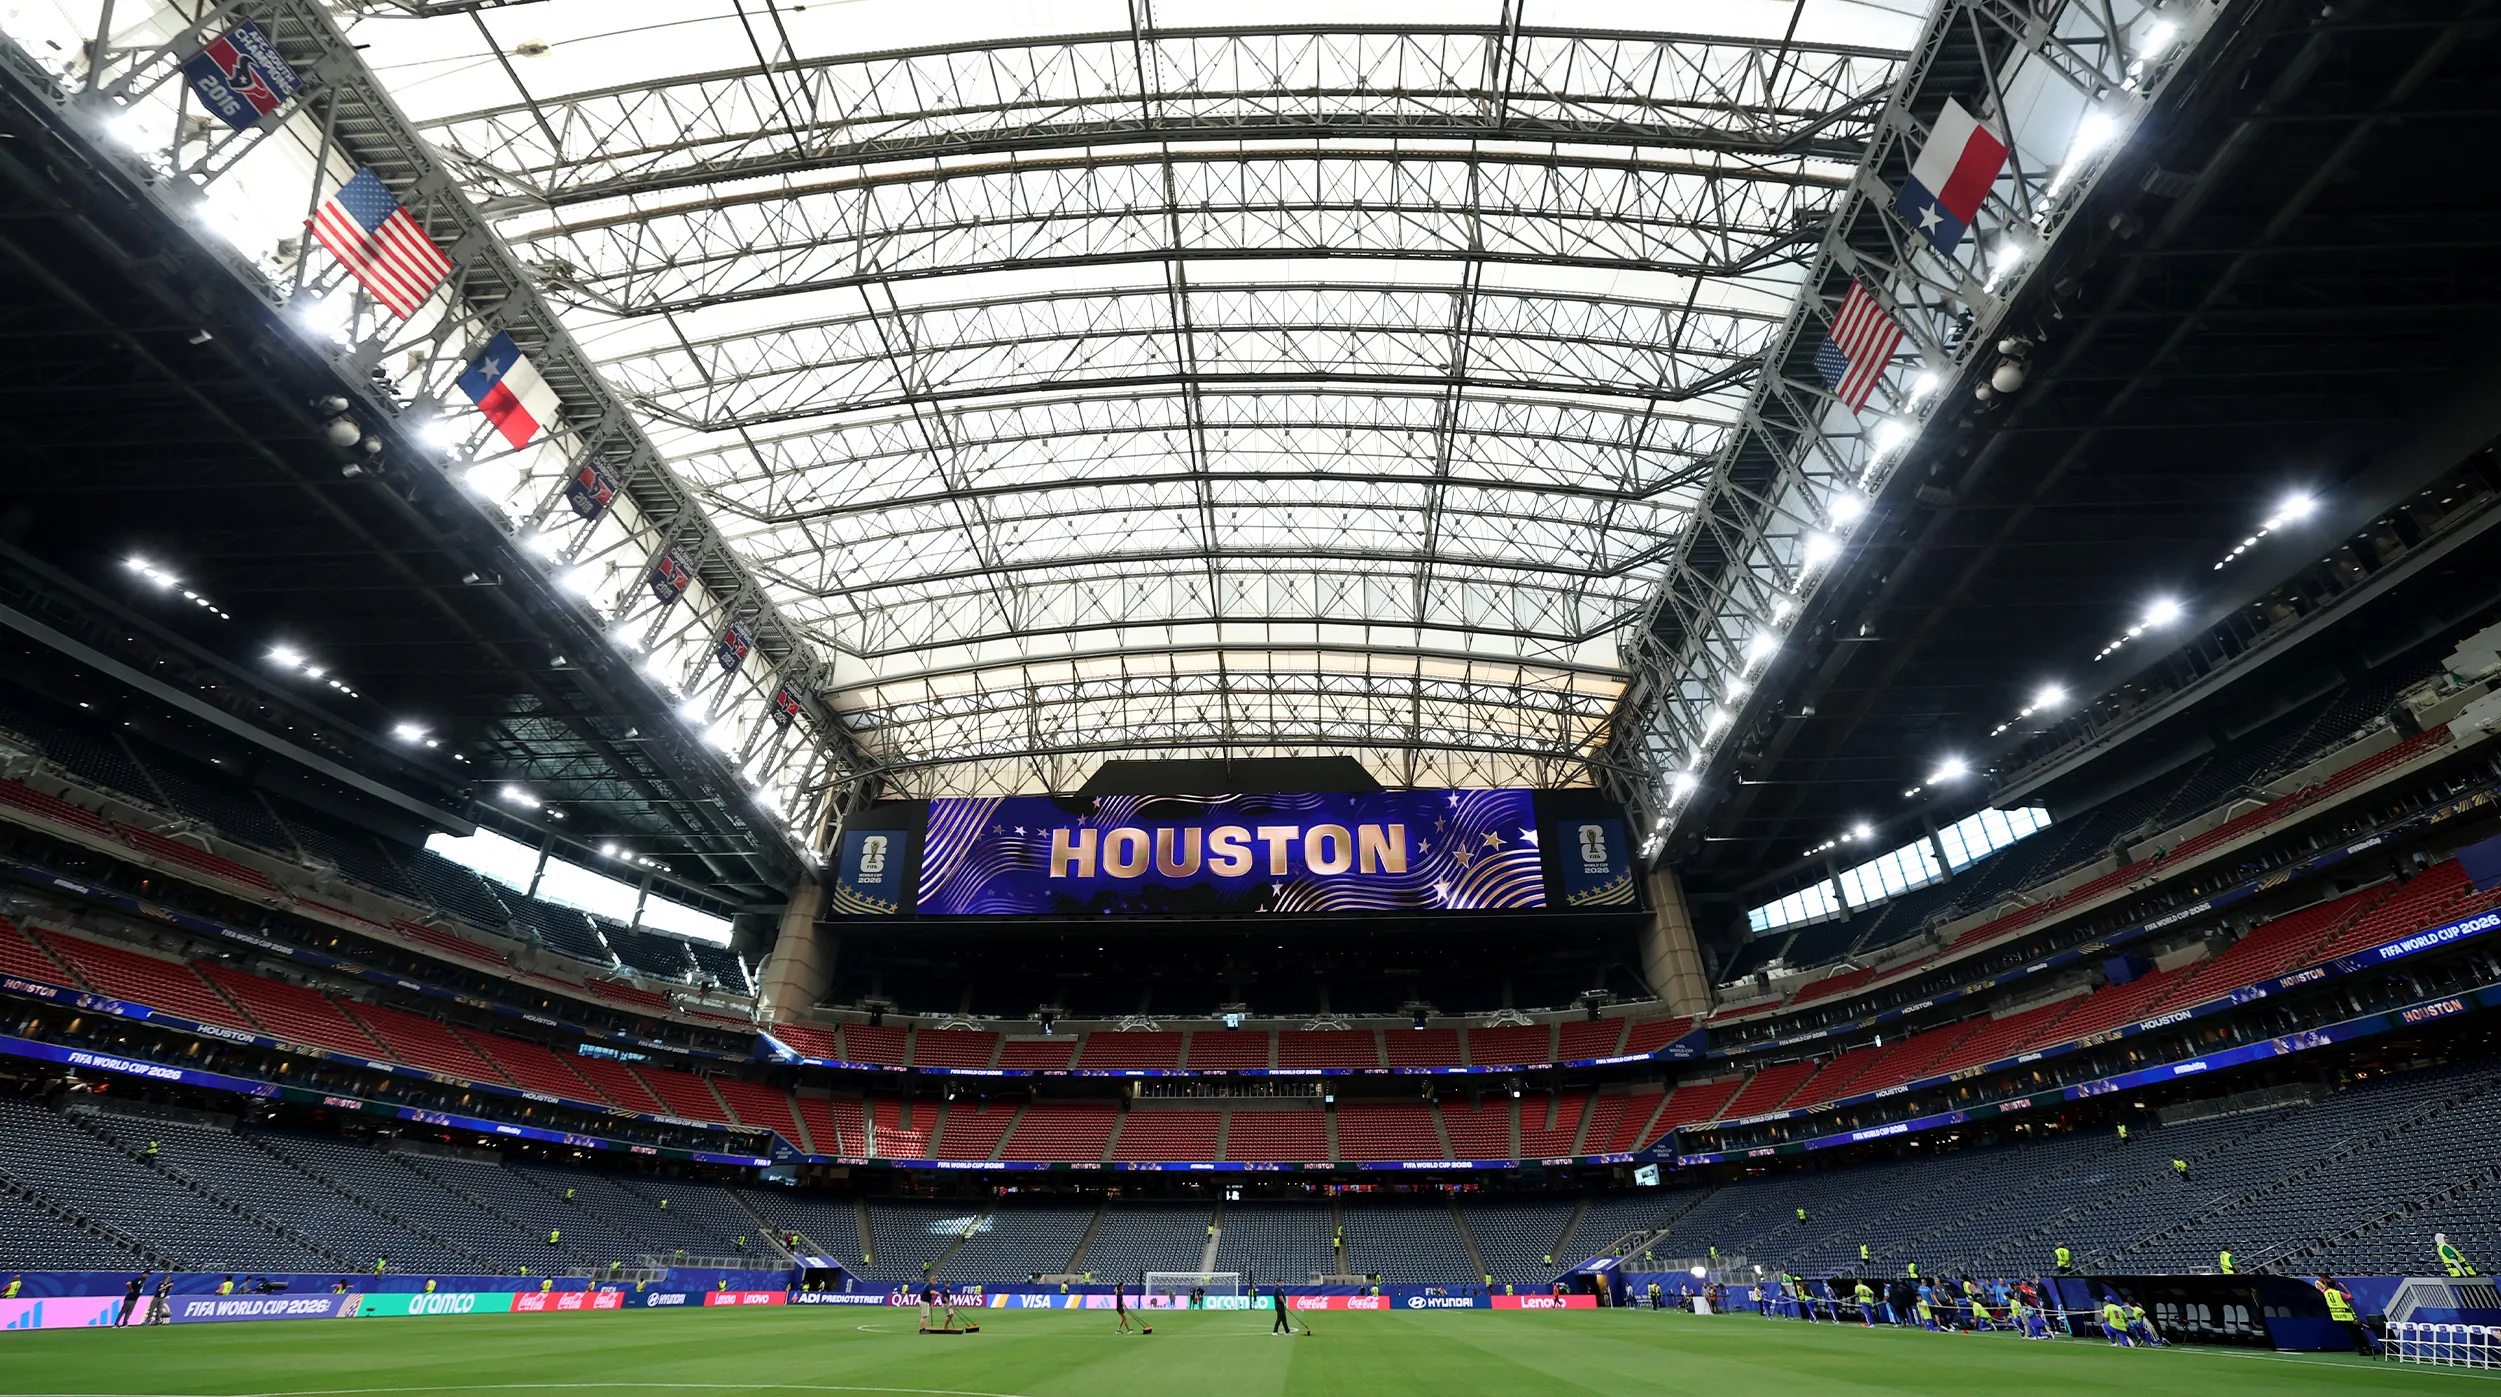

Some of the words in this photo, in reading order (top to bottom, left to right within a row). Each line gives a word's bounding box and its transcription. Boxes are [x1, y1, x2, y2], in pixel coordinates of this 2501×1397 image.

[234, 28, 295, 95] CHAMPIONS
[249, 30, 269, 51] AFC
[266, 49, 296, 82] SOUTH
[198, 74, 241, 117] 2016
[655, 580, 673, 599] 2019
[1050, 824, 1408, 878] HOUSTON
[2144, 919, 2157, 932] FIFA
[2157, 914, 2178, 927] WORLD
[2177, 909, 2190, 921] CUP
[2189, 902, 2212, 915] 2026
[221, 928, 236, 938] FIFA
[236, 932, 259, 944] WORLD
[2379, 943, 2404, 959] FIFA
[2400, 933, 2439, 953] WORLD
[2438, 925, 2461, 942] CUP
[2460, 913, 2501, 934] 2026
[2280, 967, 2325, 988] HOUSTON
[4, 978, 58, 998] HOUSTON
[1901, 1000, 1934, 1015] HOUSTON
[2402, 998, 2464, 1023] HOUSTON
[522, 1013, 558, 1027] HOUSTON
[2139, 1010, 2193, 1031] HOUSTON
[196, 1024, 256, 1043] HOUSTON
[68, 1053, 93, 1065] FIFA
[92, 1057, 129, 1071] WORLD
[128, 1061, 149, 1074] CUP
[147, 1066, 183, 1080] 2026
[521, 1091, 560, 1105] HOUSTON
[1876, 1085, 1909, 1099] HOUSTON
[323, 1096, 364, 1110] HOUSTON
[1999, 1099, 2032, 1113] HOUSTON
[1749, 1116, 1765, 1124] WORLD
[1764, 1114, 1774, 1122] CUP
[1774, 1112, 1790, 1120] 2026
[1853, 1132, 1864, 1141] FIFA
[1863, 1130, 1880, 1139] WORLD
[1879, 1127, 1890, 1136] CUP
[1889, 1124, 1908, 1133] 2026
[837, 1157, 869, 1165] HOUSTON
[408, 1293, 475, 1314] aramco
[517, 1292, 548, 1311] Coca-Cola
[557, 1292, 587, 1311] Coca-Cola
[593, 1291, 618, 1309] Coca-Cola
[658, 1293, 686, 1305] HYUNDAI
[714, 1292, 736, 1305] Lenovo
[743, 1292, 769, 1304] Lenovo
[798, 1293, 821, 1304] ADI
[891, 1293, 921, 1307] QATA
[1020, 1294, 1051, 1309] VISA
[1296, 1295, 1330, 1310] Coca-Cola
[1347, 1295, 1380, 1310] Coca-Cola
[1428, 1297, 1473, 1307] HYUNDAI
[184, 1302, 216, 1317] FIFA
[216, 1301, 264, 1316] WORLD
[262, 1300, 288, 1315] CUP
[286, 1299, 328, 1314] 2026
